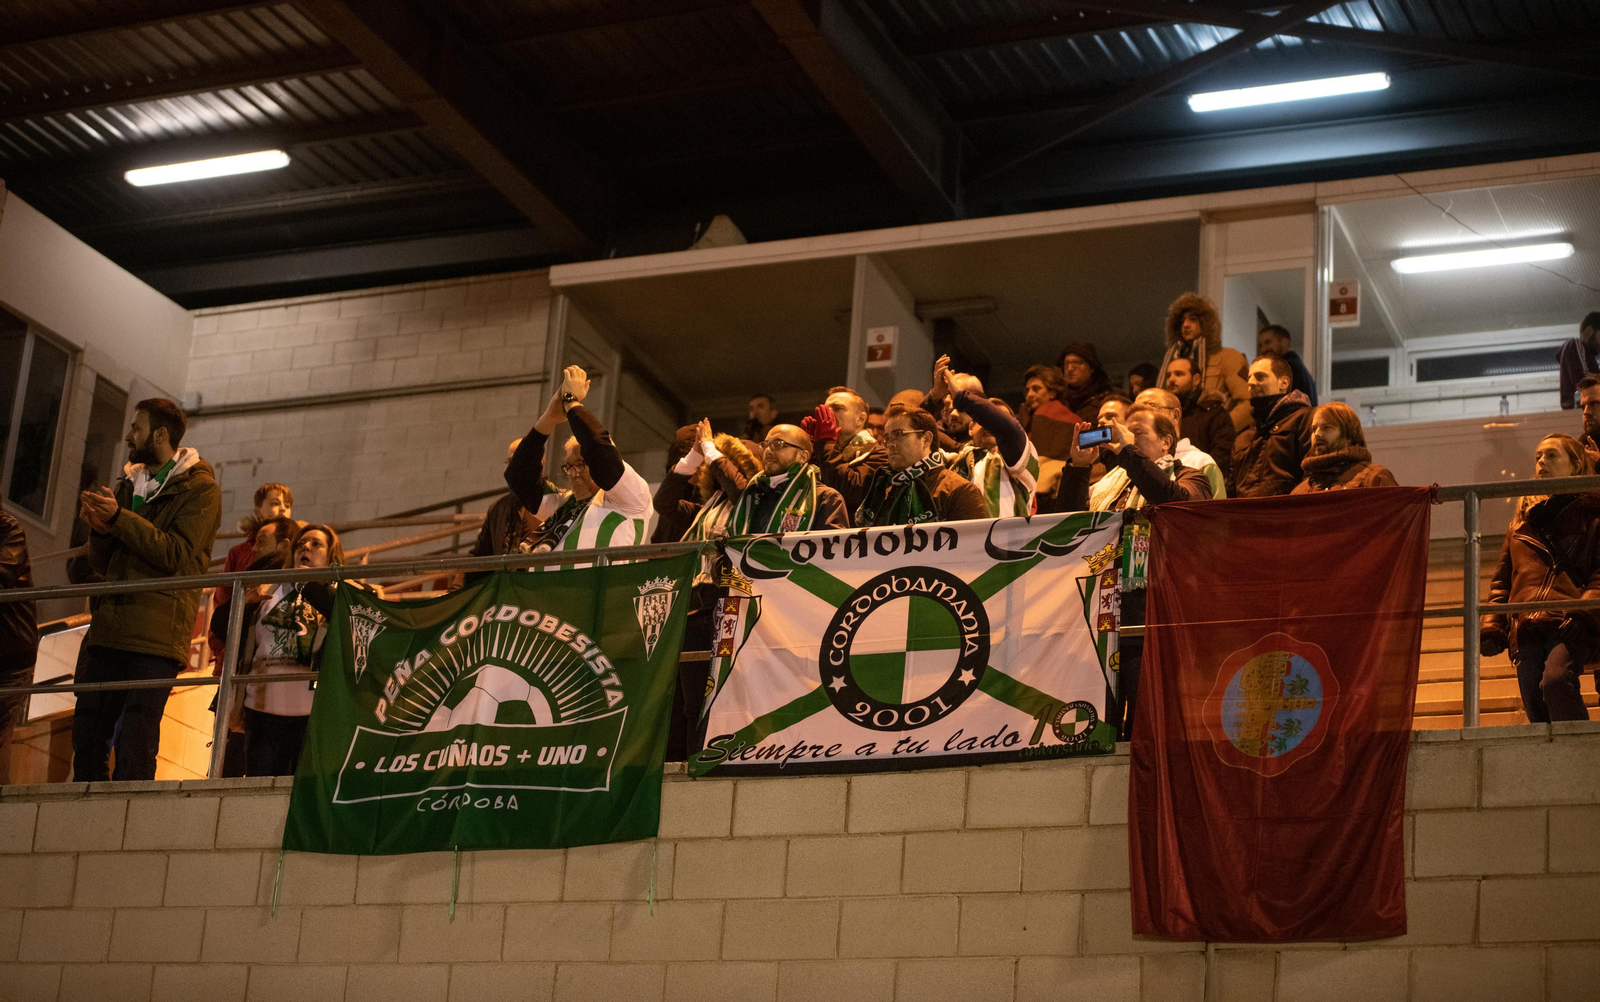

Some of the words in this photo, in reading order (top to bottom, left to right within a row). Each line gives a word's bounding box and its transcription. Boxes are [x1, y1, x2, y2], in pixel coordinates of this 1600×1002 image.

[373, 648, 434, 725] PEÑA
[439, 604, 625, 709] CORDOBESISTA
[847, 696, 952, 727] 2001
[373, 753, 421, 773] LOS
[422, 738, 511, 771] CUÑAOS
[537, 744, 588, 766] UNO
[697, 733, 843, 769] Siempre
[855, 742, 879, 756] a
[892, 735, 930, 756] tu
[943, 723, 1023, 752] lado
[416, 792, 519, 812] CÓRDOBA
